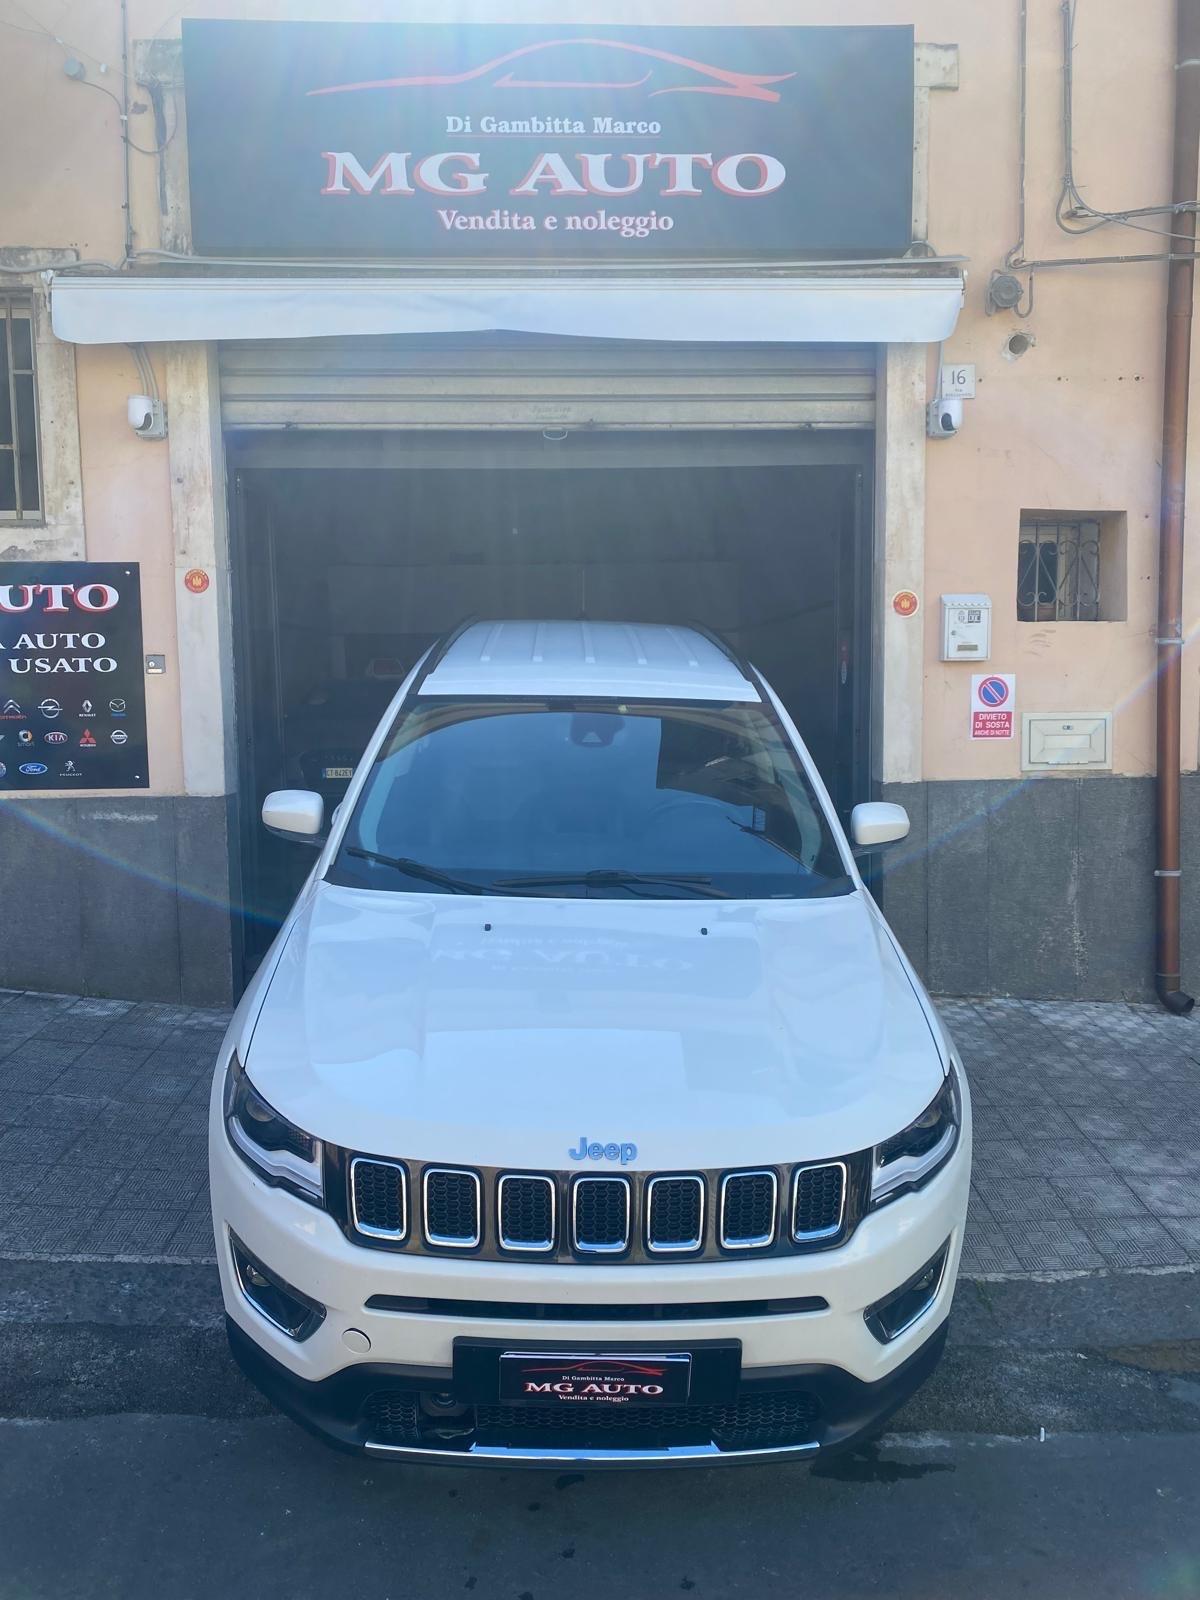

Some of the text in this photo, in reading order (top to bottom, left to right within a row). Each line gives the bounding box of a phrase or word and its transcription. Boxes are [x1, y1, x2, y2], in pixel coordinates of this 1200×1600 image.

[446, 115, 662, 135] Di Gambitta Marco
[320, 151, 787, 198] MG AUTO
[437, 209, 674, 238] Vendita e noleggio
[951, 369, 966, 385] 16
[12, 632, 106, 650] AUTO
[8, 657, 118, 674] USATO
[975, 721, 1010, 729] DI SOSTA
[979, 713, 1007, 721] DIVIETO
[568, 1136, 638, 1165] Jeep
[524, 1382, 664, 1395] MG AUTO
[596, 1395, 629, 1403] noleggio
